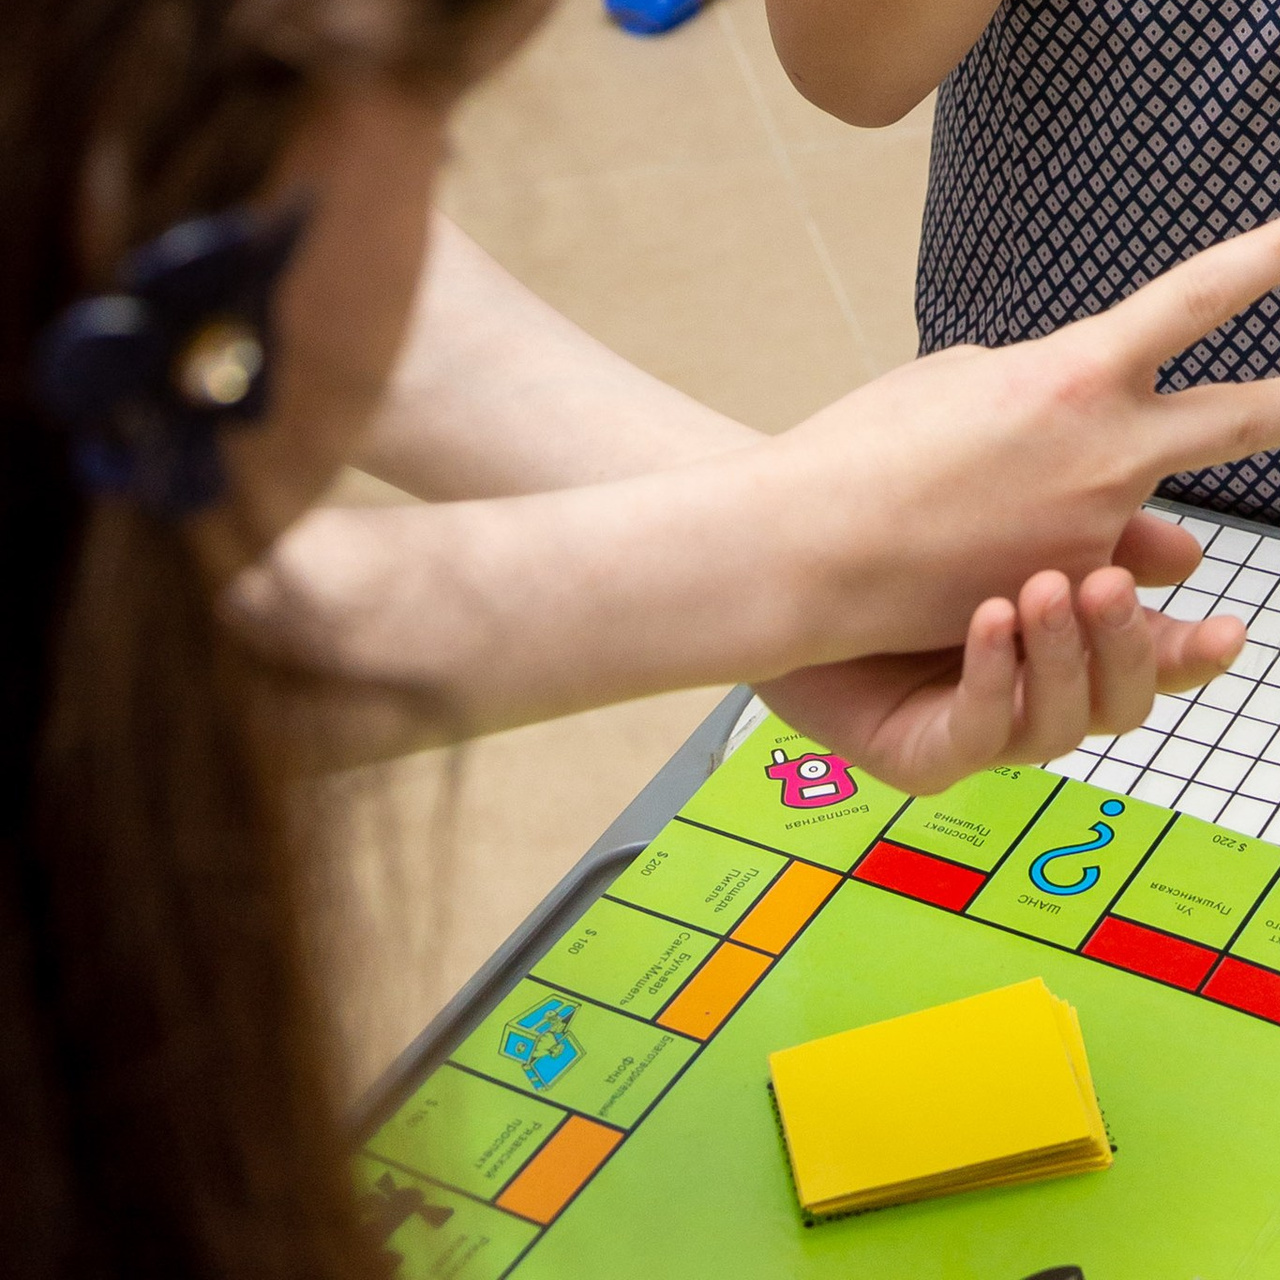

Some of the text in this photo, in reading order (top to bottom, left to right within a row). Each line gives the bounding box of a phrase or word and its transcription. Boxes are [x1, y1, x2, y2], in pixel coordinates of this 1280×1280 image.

[785, 803, 870, 831] Бесплатная
[933, 811, 991, 837] Пушкина
[923, 821, 986, 848] Проспект
[704, 868, 741, 904] Пигаль
[713, 867, 760, 914] Площадь
[1150, 880, 1232, 917] Пушкинская
[1017, 893, 1062, 915] ШАНС
[619, 931, 691, 1007] Санкт-Мишель
[649, 952, 692, 995] Бульвар
[605, 1054, 635, 1085] фонд
